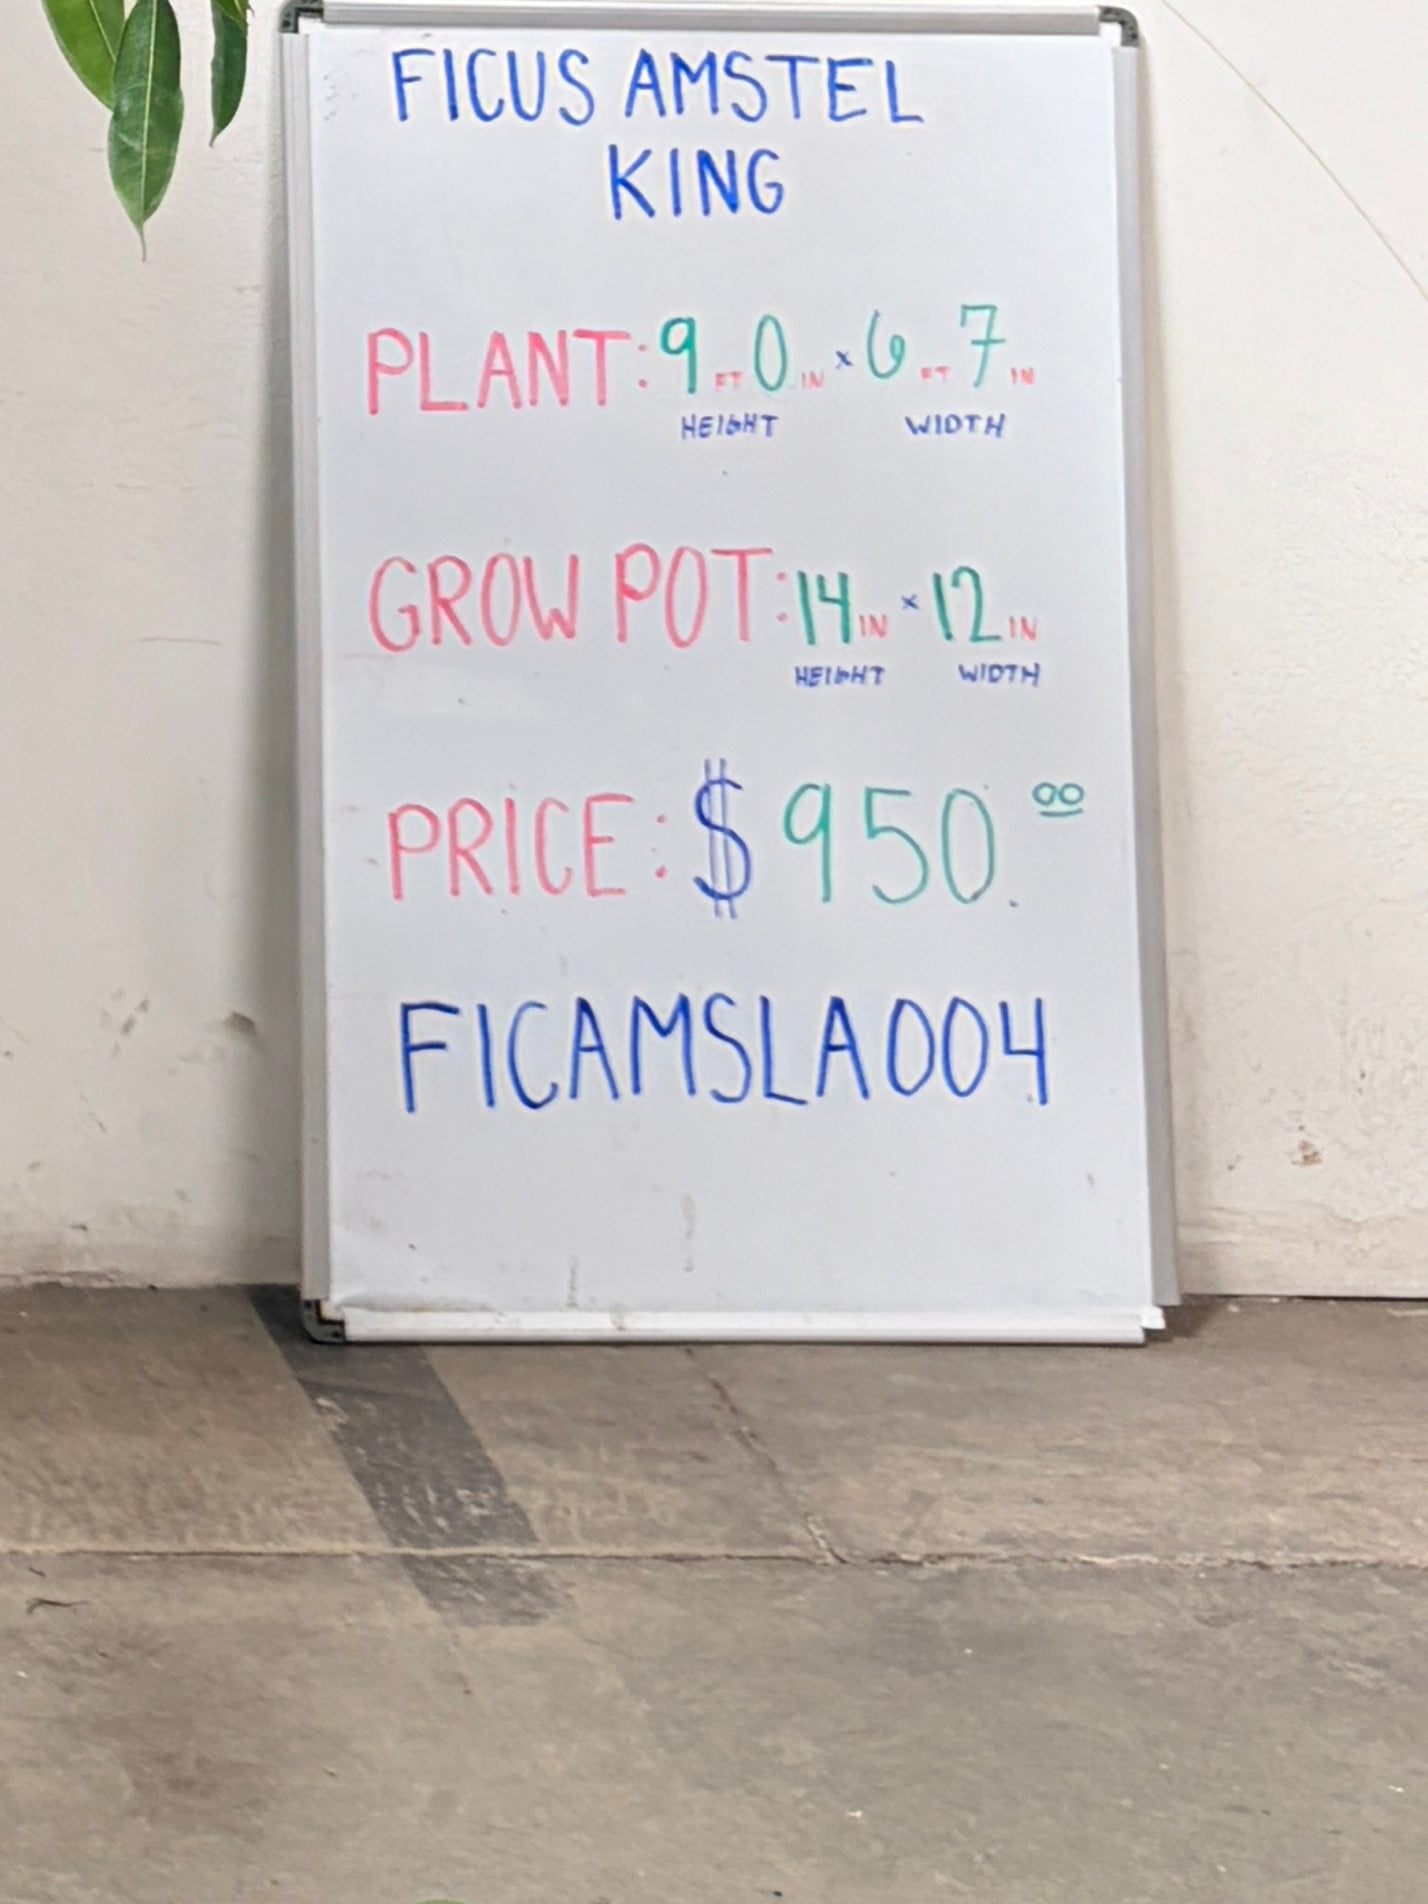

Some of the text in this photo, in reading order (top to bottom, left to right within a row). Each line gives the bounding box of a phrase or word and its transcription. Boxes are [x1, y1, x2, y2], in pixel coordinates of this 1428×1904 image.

[391, 48, 925, 127] FICUS AMSTEL
[607, 143, 785, 220] KING
[366, 326, 649, 417] PLANT:
[680, 413, 1007, 440] HEIGHT WIDTH
[367, 553, 580, 653] GROW
[614, 543, 789, 649] POT:
[794, 662, 1041, 689] HEIGHT WIDTH
[387, 792, 670, 902] PRICE:
[399, 992, 1050, 1114] FICAMSLA004
